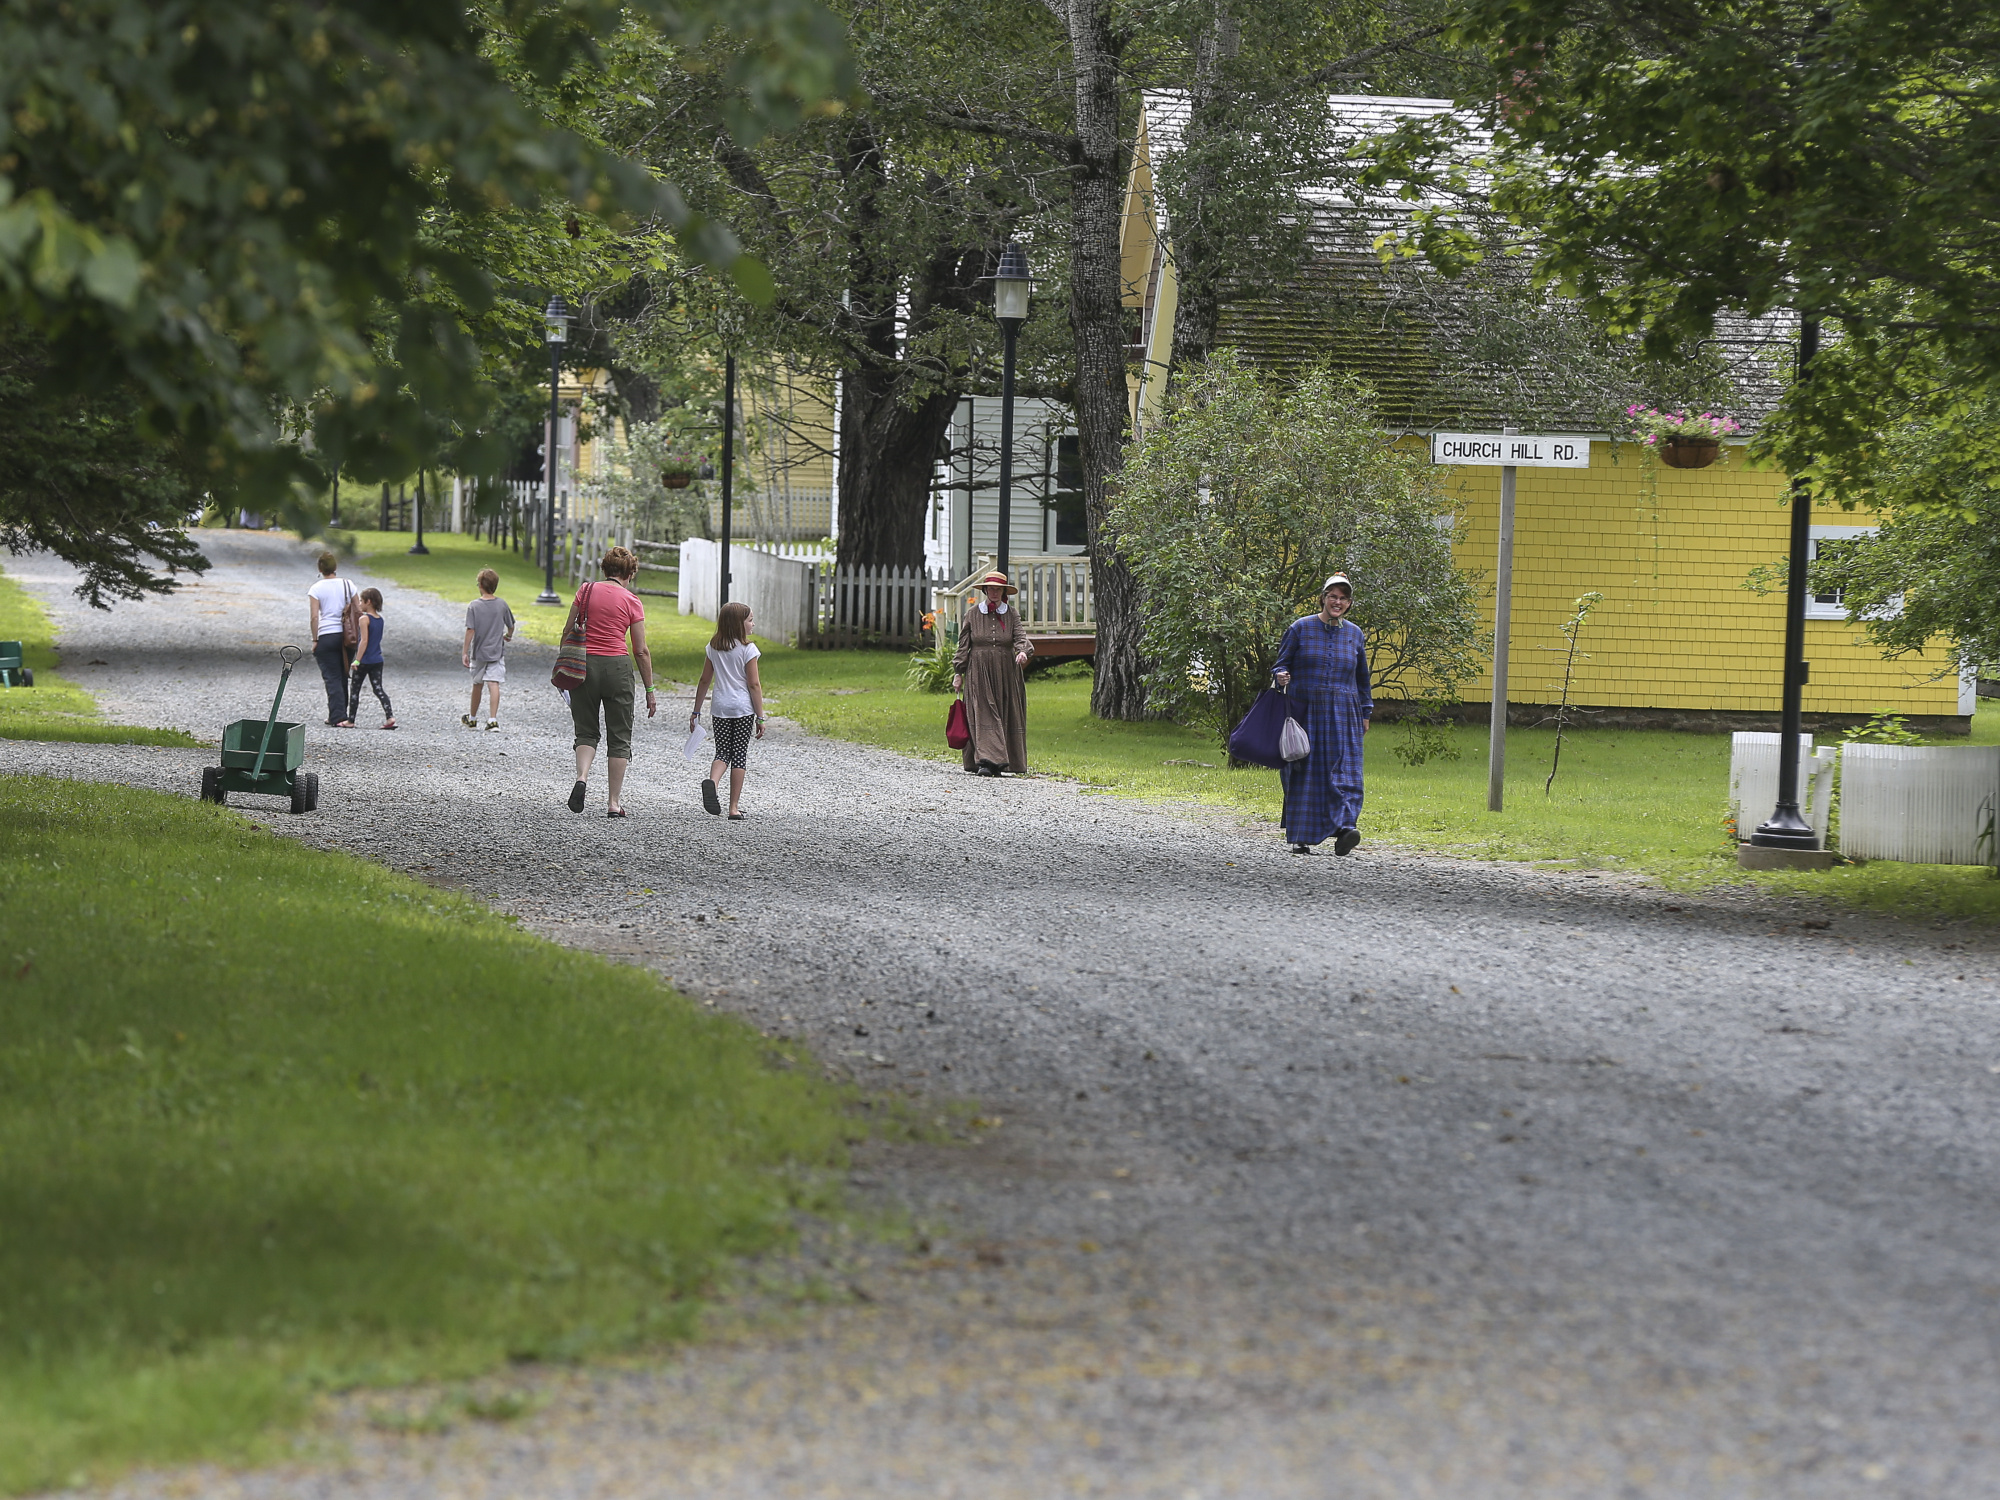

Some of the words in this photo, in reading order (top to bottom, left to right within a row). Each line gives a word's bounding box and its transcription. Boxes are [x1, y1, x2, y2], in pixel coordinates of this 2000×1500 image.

[1443, 441, 1502, 458] CHURCH
[1511, 443, 1543, 460] HILL
[1553, 444, 1579, 461] RD.
